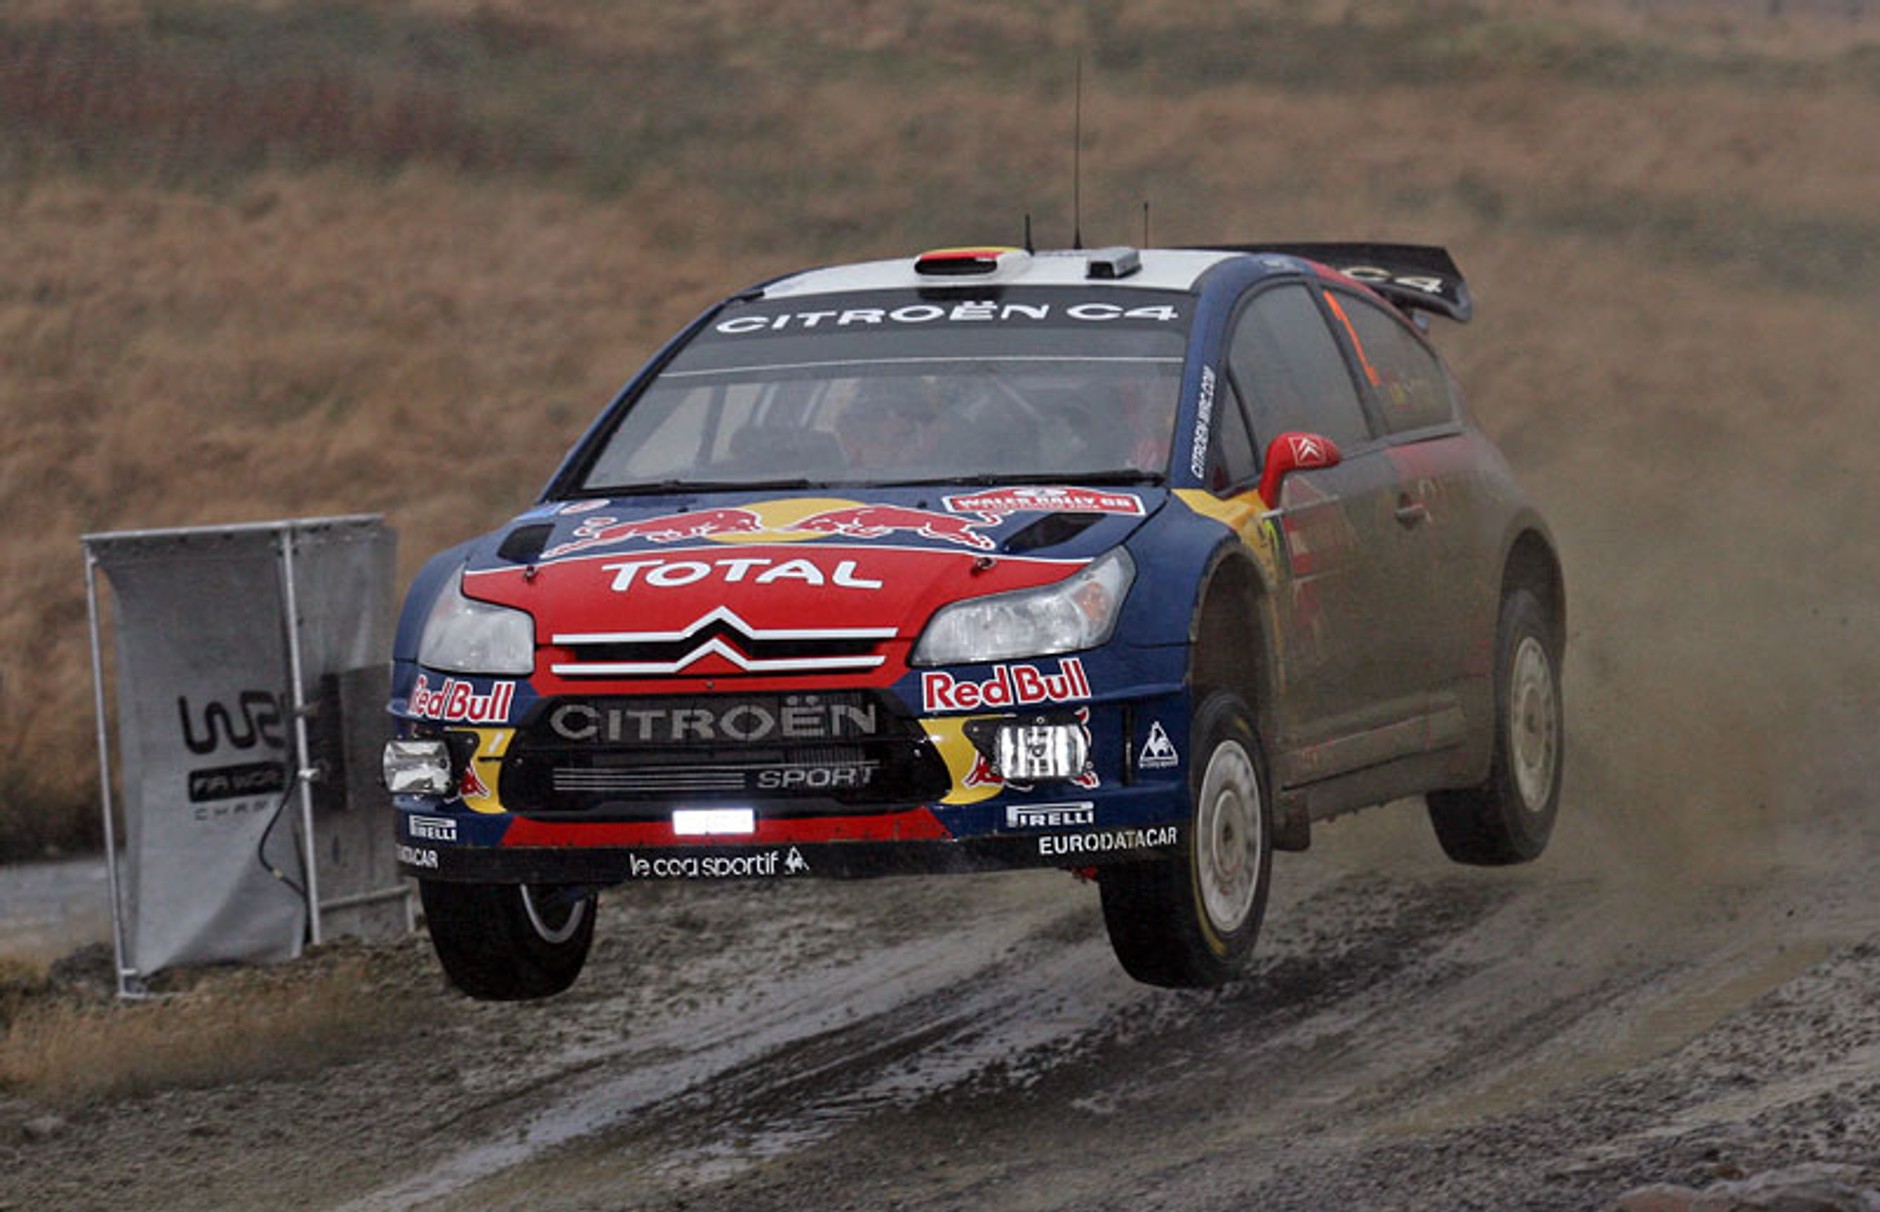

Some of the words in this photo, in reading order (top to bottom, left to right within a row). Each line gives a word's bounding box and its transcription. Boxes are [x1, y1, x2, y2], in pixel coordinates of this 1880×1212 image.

[716, 300, 1049, 333] CITROËN
[1066, 303, 1179, 321] C4
[601, 558, 884, 592] TOTAL
[922, 664, 1014, 712] Red
[1010, 657, 1092, 704] Bull
[446, 680, 515, 723] Bull
[550, 694, 877, 742] CITROËN
[757, 765, 878, 788] SPORT
[1006, 801, 1095, 828] PIRELLI
[1038, 826, 1178, 855] EURODATACAR
[629, 852, 650, 877] le
[701, 850, 779, 877] sportif
